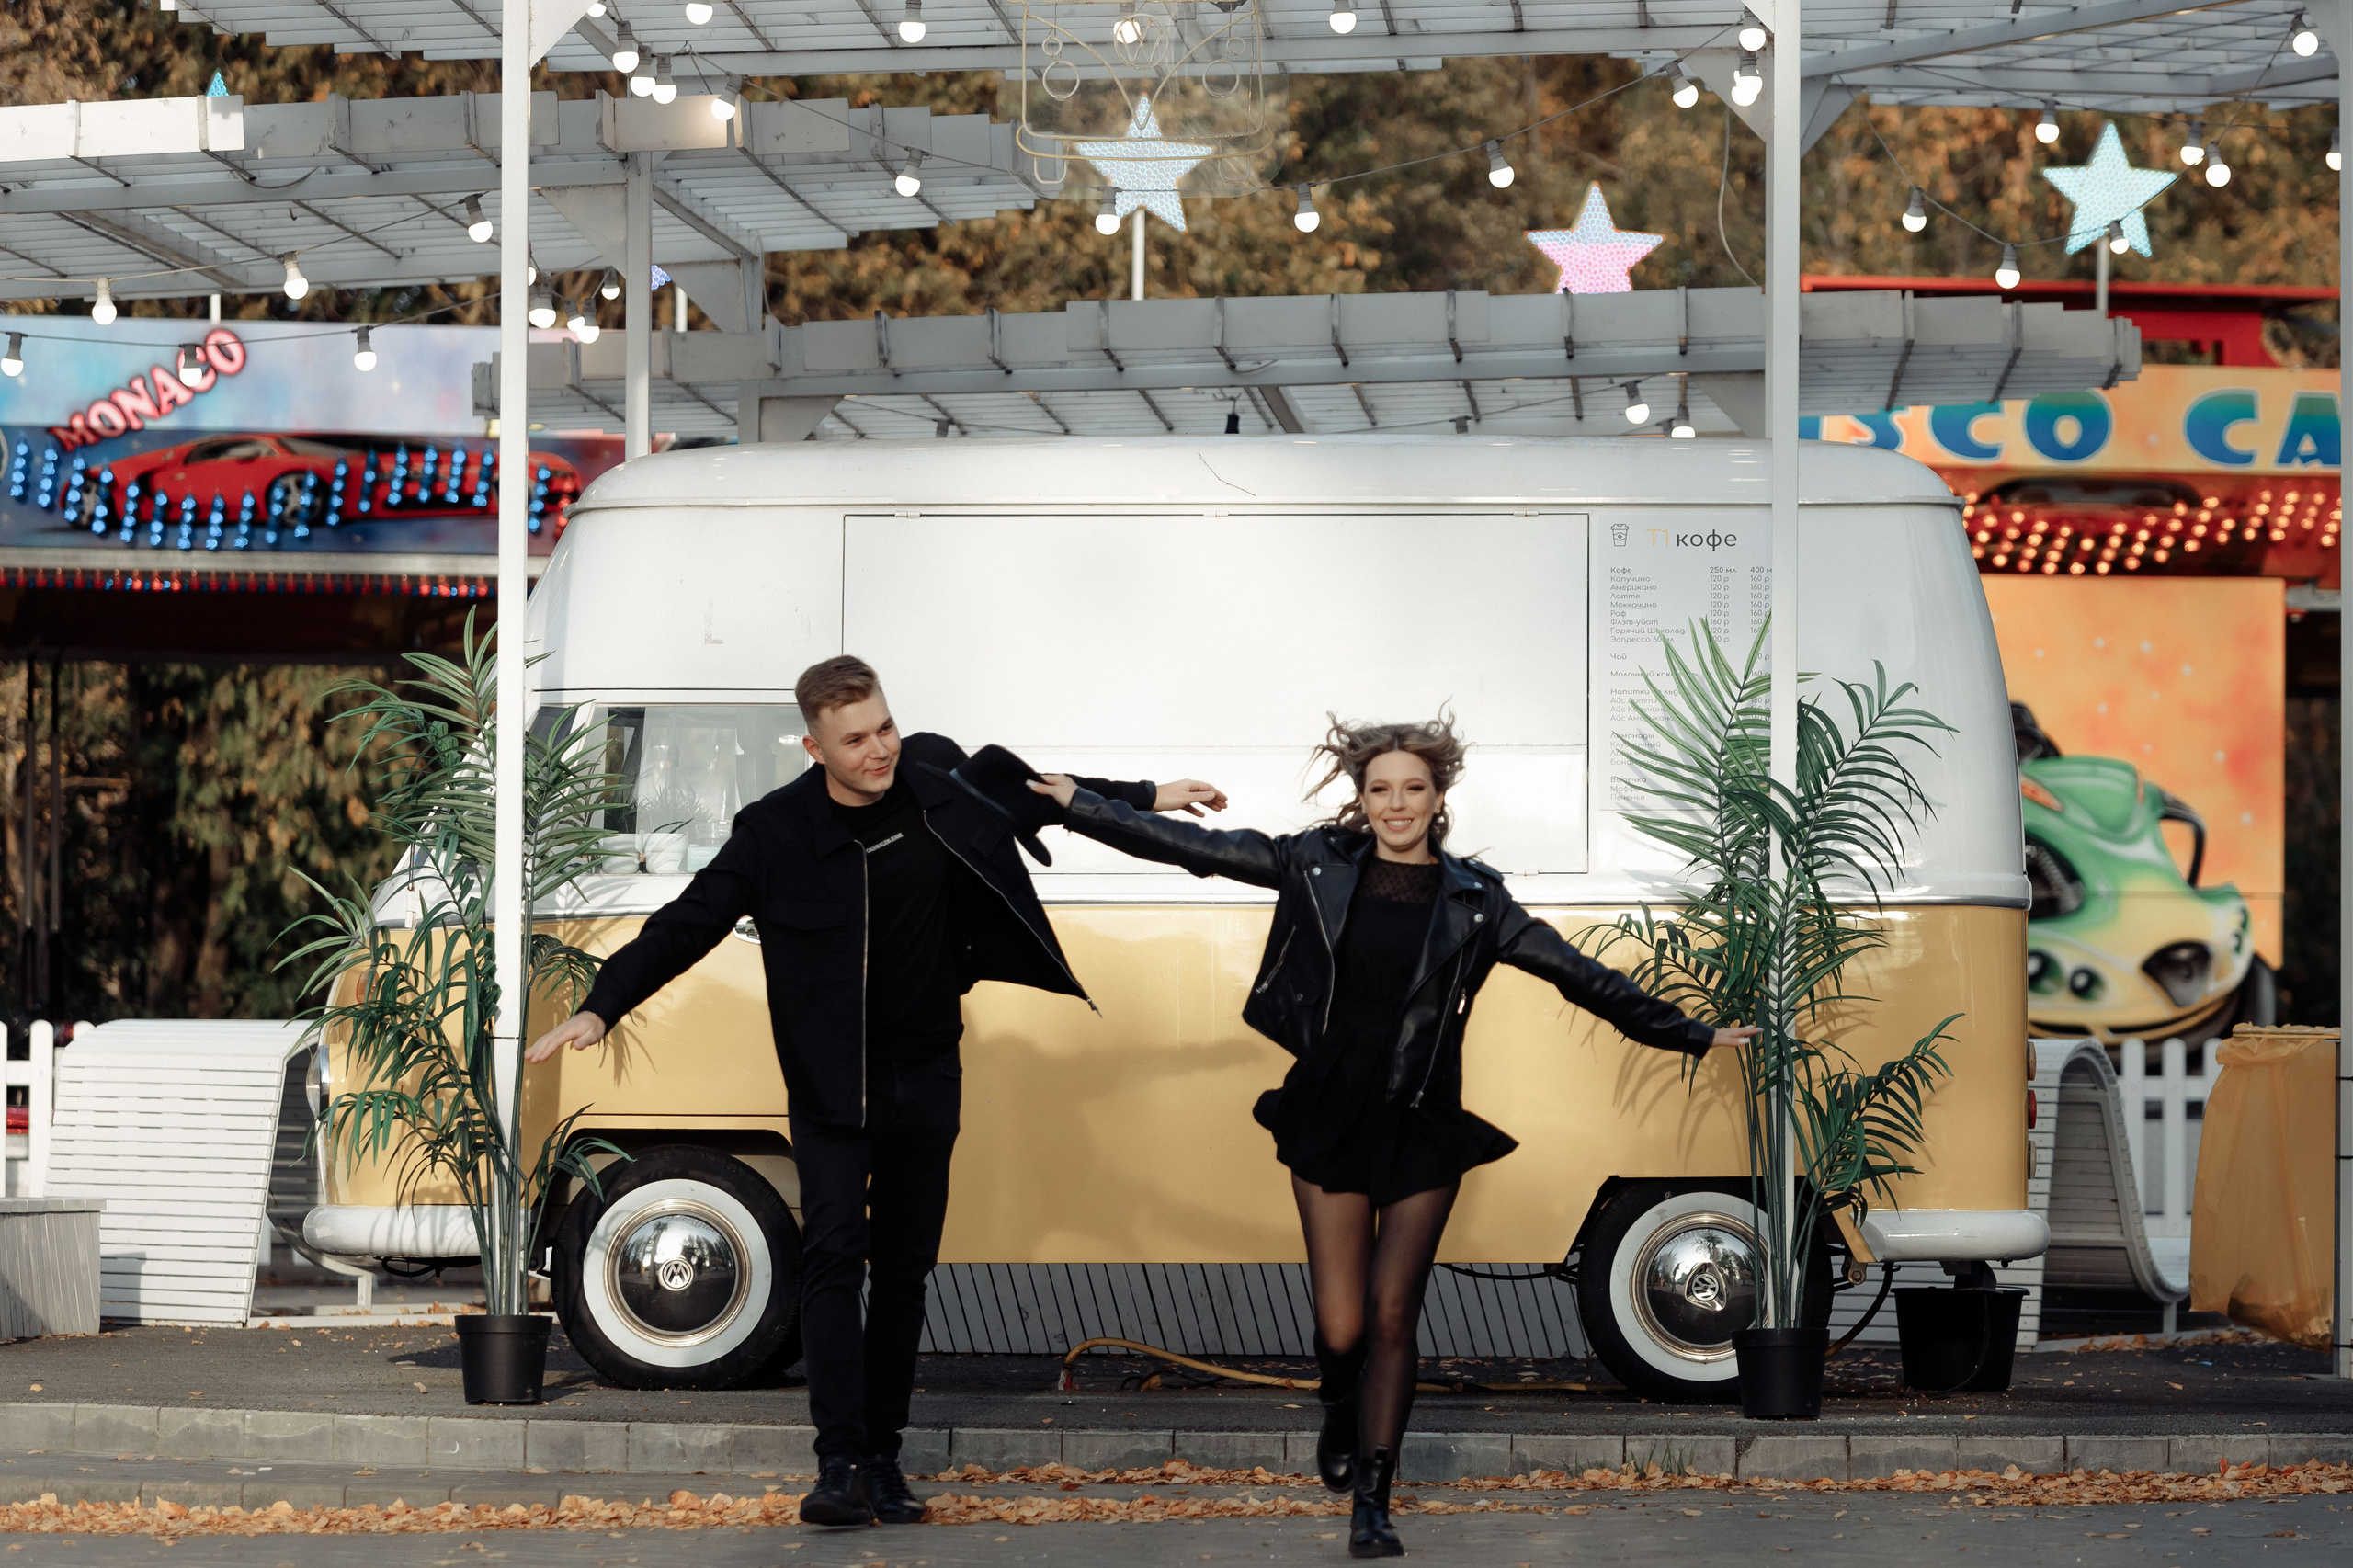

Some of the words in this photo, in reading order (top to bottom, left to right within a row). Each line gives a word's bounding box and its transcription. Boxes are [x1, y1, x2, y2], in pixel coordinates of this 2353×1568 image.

[1677, 528, 1737, 551] кофе
[1610, 566, 1632, 574] Кофе
[1610, 575, 1650, 584] Капучино
[1610, 584, 1657, 592] Американо
[1610, 619, 1658, 627] Флэт-уйат
[1610, 636, 1651, 644] Эспрессо
